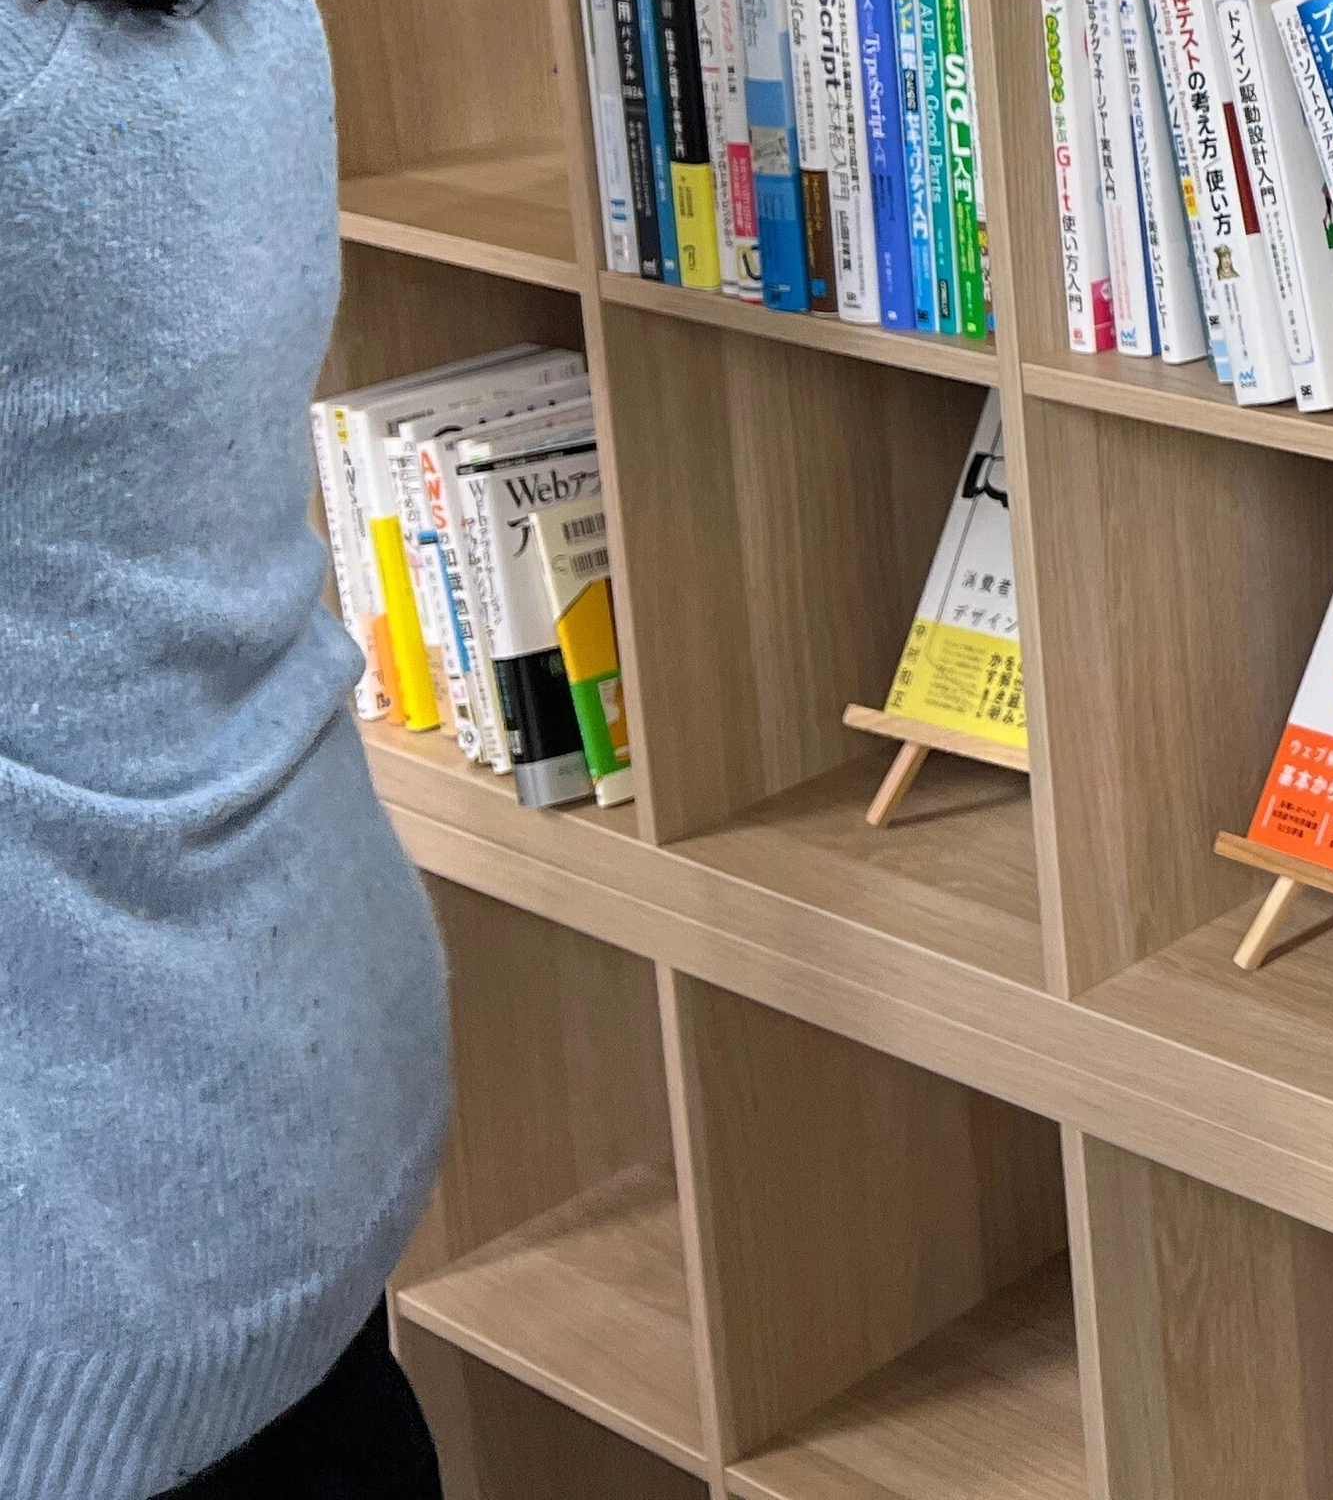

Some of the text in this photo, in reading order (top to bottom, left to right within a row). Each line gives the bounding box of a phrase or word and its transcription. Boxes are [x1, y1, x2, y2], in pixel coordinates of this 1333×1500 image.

[1226, 9, 1277, 207] ドメイン駆動設計入門
